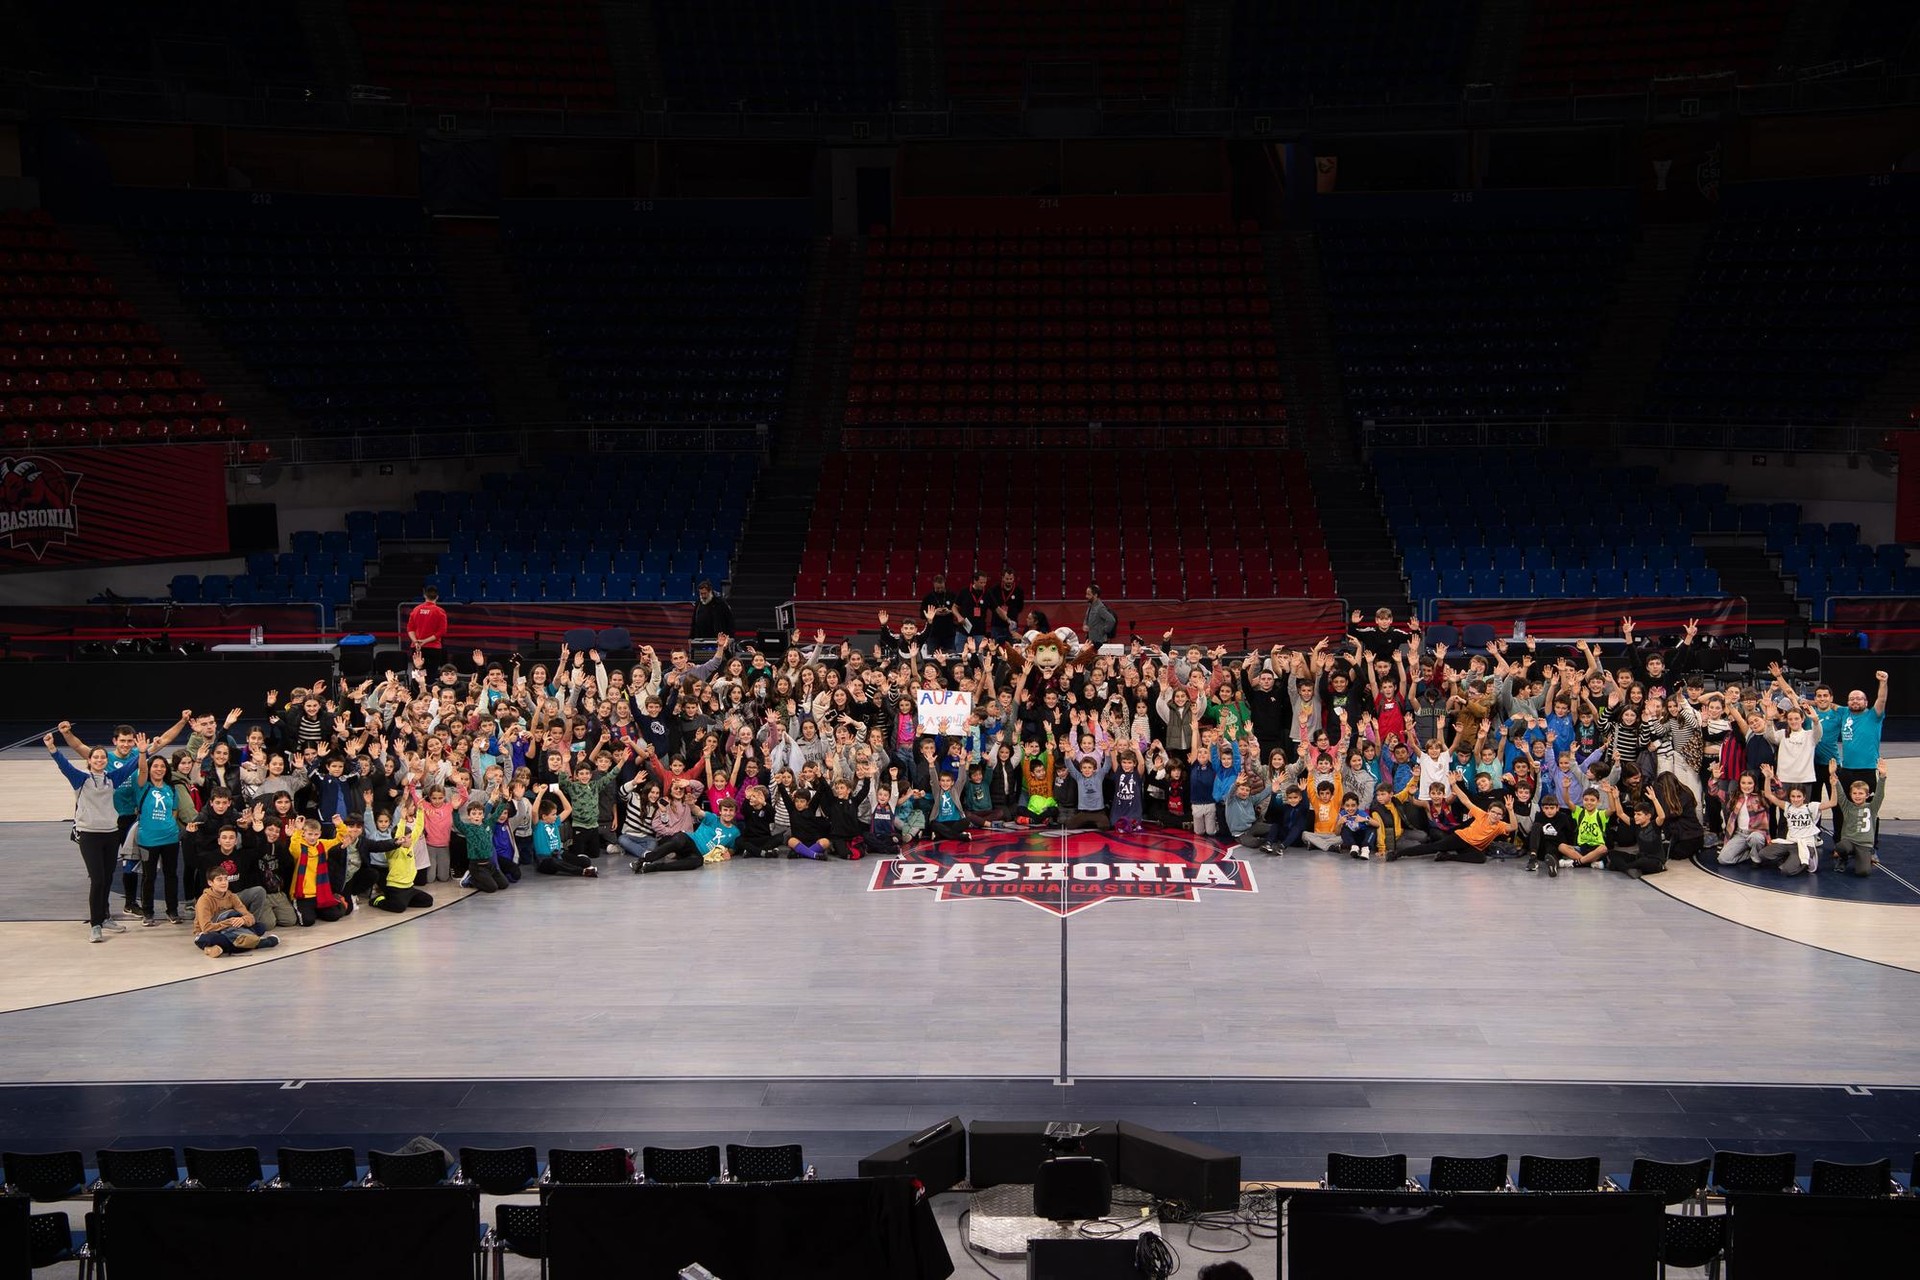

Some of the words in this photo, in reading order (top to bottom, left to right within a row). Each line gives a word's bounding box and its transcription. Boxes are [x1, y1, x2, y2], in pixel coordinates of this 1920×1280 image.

[251, 193, 272, 204] 212
[633, 200, 654, 211] 213
[1039, 199, 1059, 208] 214
[0, 508, 74, 532] BASKONIA
[920, 688, 968, 706] AUPA
[1861, 807, 1871, 833] 3
[893, 862, 1236, 885] BASKONIA
[960, 883, 1061, 895] VITORIA
[1070, 883, 1179, 895] GASTEIZ
